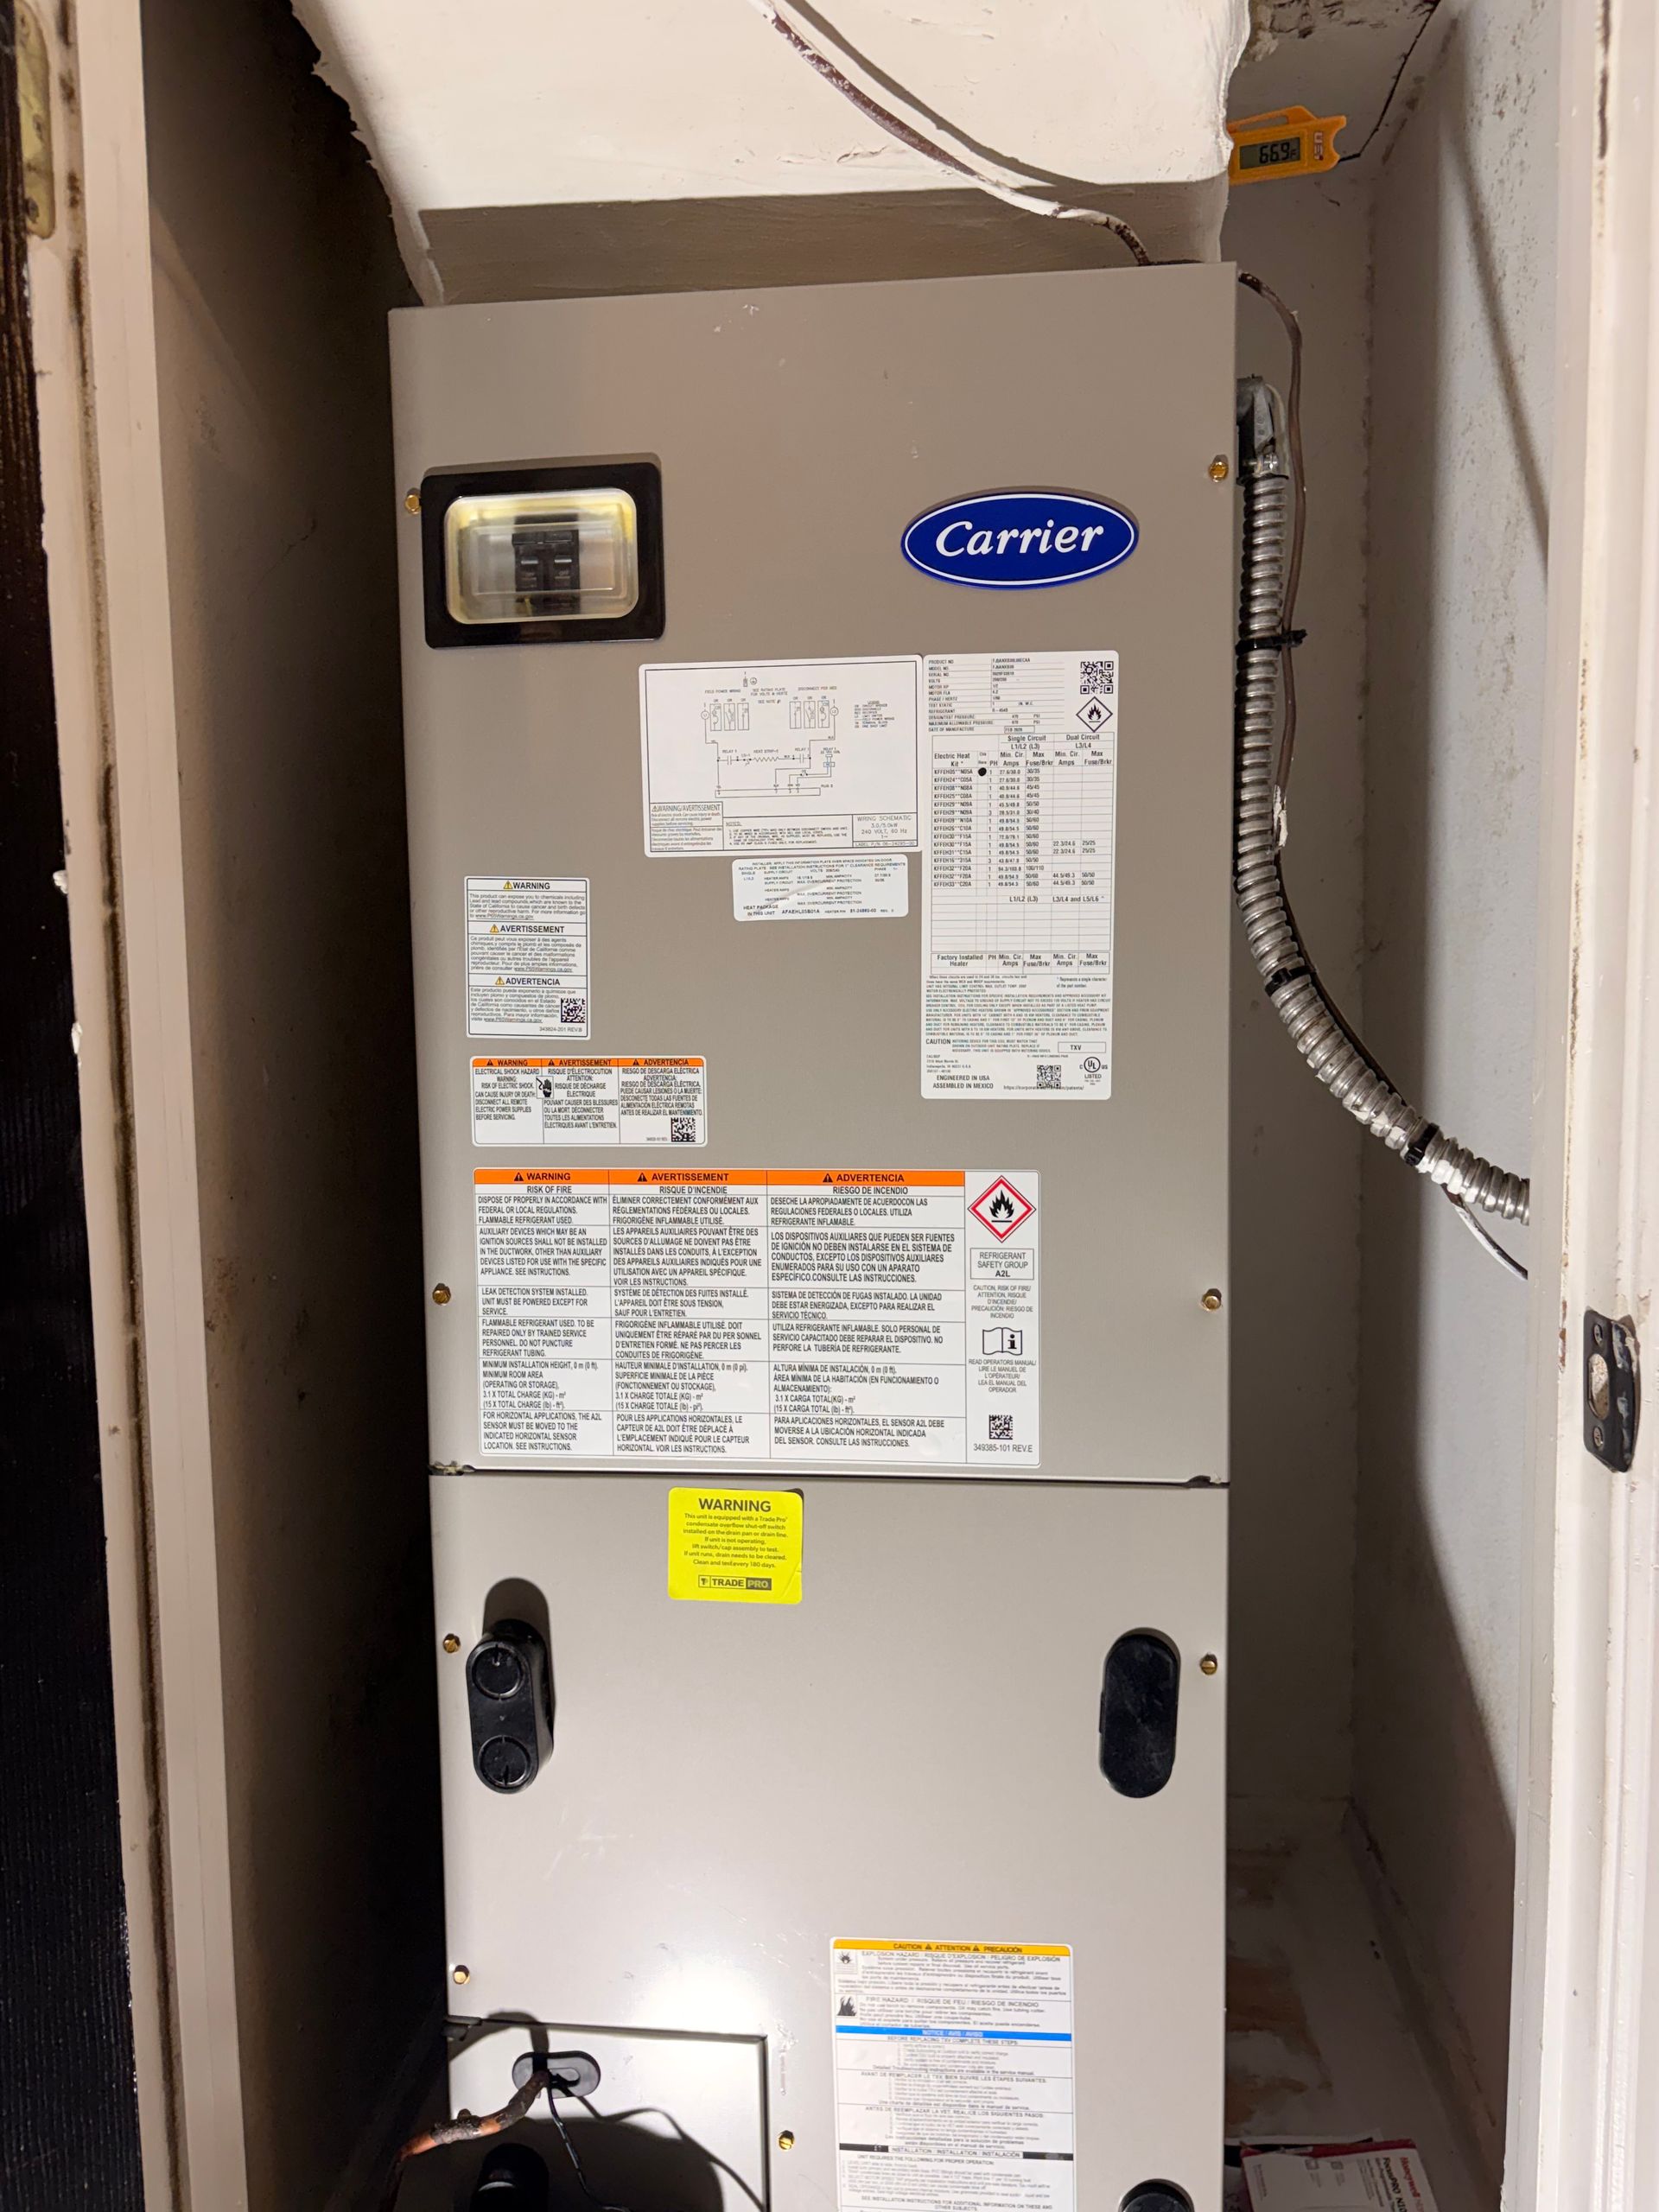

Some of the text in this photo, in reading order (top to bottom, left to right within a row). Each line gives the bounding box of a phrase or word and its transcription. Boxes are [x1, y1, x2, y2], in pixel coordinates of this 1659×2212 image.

[936, 518, 1104, 557] Carrier
[526, 1173, 570, 1181] WARNING
[652, 1173, 728, 1181] AVERTISSEMENT
[643, 1195, 693, 1205] CORRECTEMENT
[695, 1195, 744, 1205] CONFORMÉMENT
[746, 1195, 759, 1205] AUX
[658, 1216, 700, 1225] INFLAMMABLE
[977, 1260, 1002, 1268] SAFETY
[499, 1287, 531, 1296] DETECTION
[774, 1436, 786, 1445] DEL
[817, 1437, 848, 1446] CONSULTE
[849, 1438, 861, 1446] LAS
[698, 1498, 772, 1512] WARNING
[712, 1579, 768, 1588] TRADE PRO
